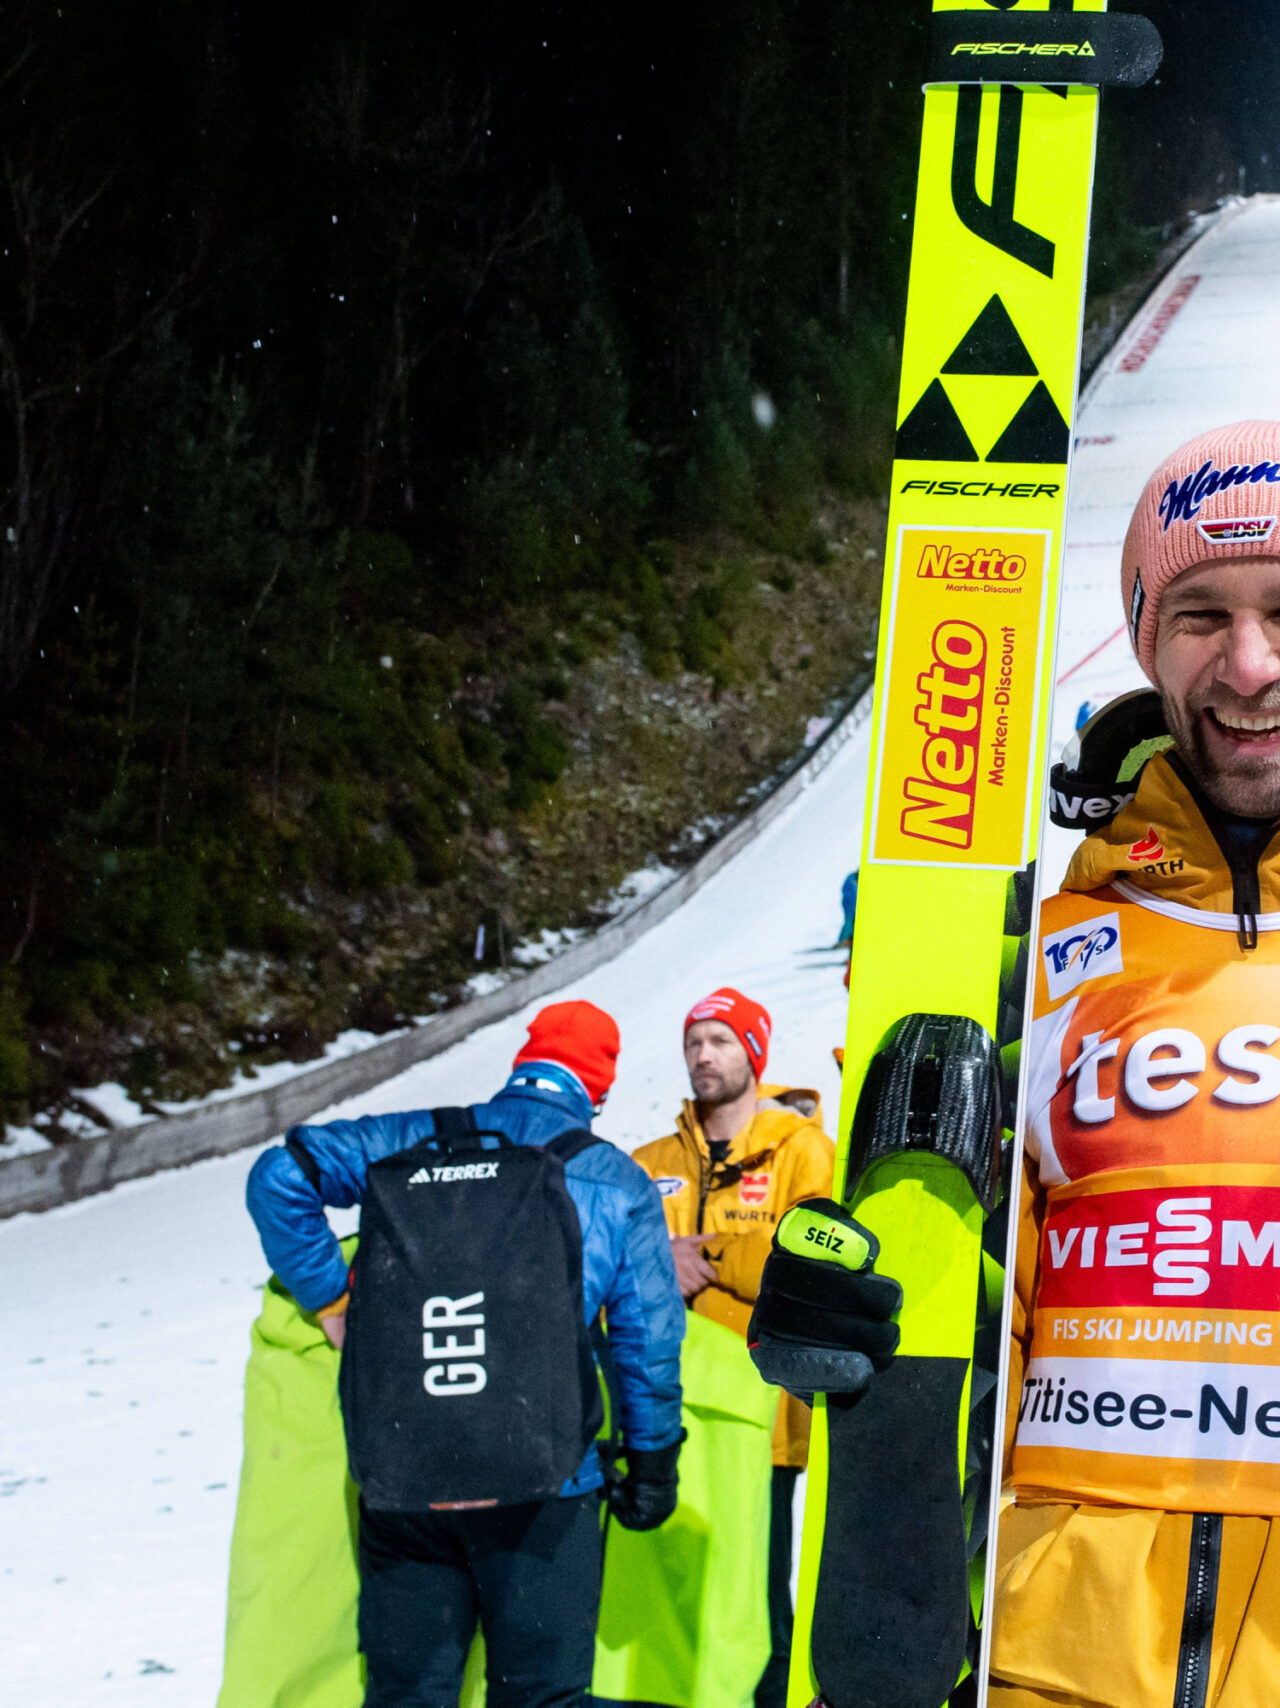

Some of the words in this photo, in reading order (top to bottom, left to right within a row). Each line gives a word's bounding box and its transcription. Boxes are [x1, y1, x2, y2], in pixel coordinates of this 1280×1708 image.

[951, 43, 1079, 56] FISCHER
[900, 480, 1061, 498] FISCHER
[1234, 521, 1272, 538] DSV
[917, 545, 1027, 581] Netto
[945, 583, 1022, 594] Marken-Discount
[988, 626, 1016, 787] Marken-Discount
[900, 619, 988, 850] Netto
[1062, 945, 1104, 970] FIS
[432, 1162, 500, 1182] TERREX
[423, 1291, 488, 1397] GER
[1053, 1318, 1079, 1340] FIS
[1084, 1318, 1122, 1340] SKI
[1128, 1320, 1273, 1347] JUMPING
